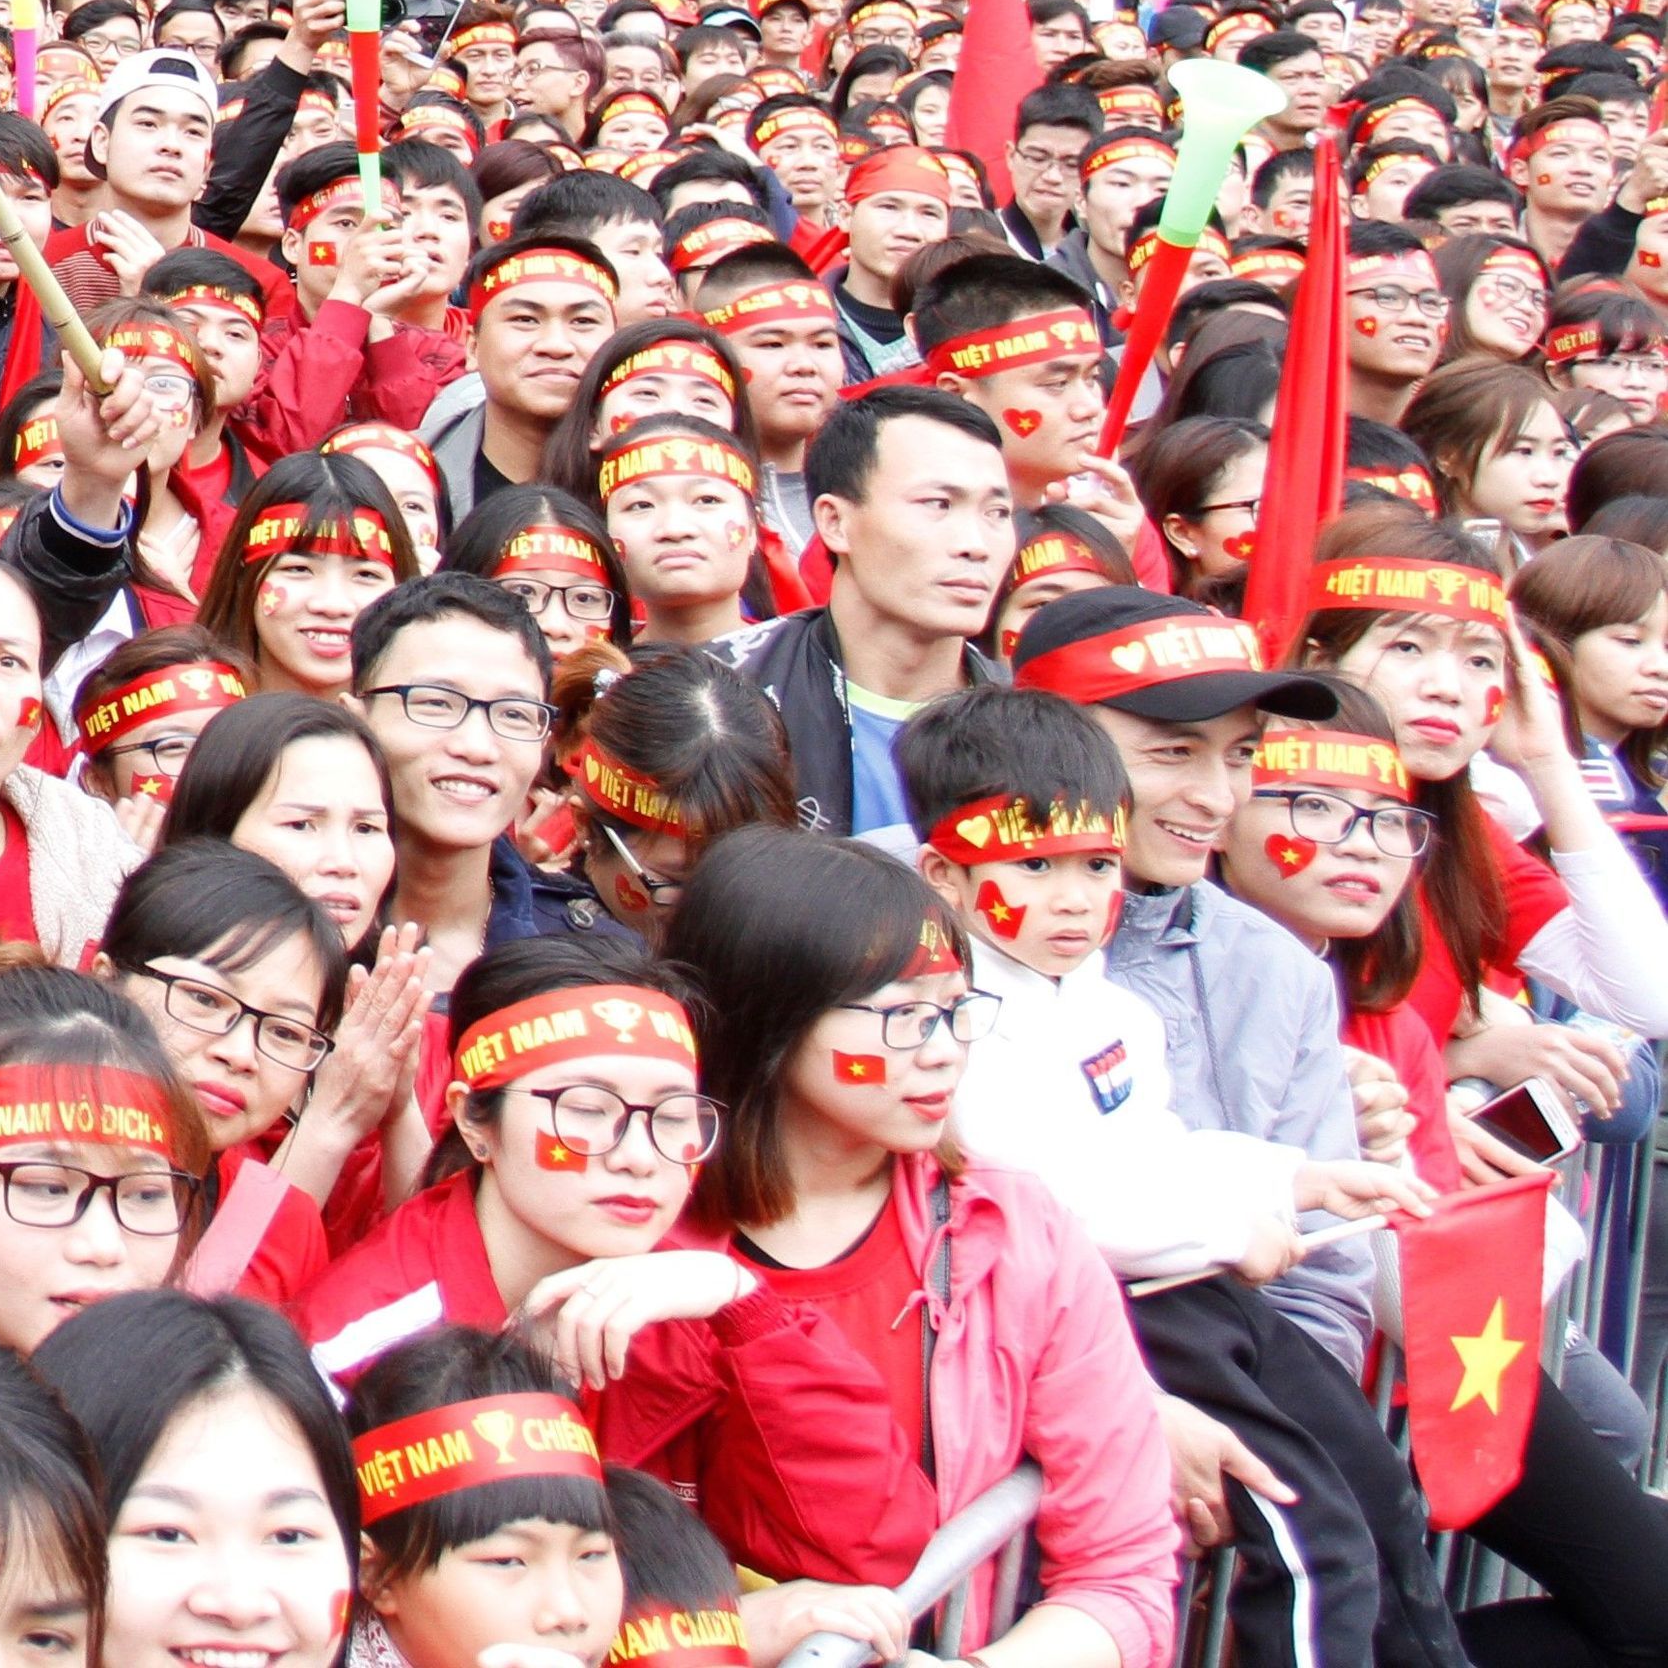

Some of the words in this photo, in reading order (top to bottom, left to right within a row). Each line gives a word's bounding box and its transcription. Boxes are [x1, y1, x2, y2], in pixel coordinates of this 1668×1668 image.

[951, 343, 992, 369] VIỆT
[995, 330, 1049, 359] NAM
[1019, 538, 1066, 575] NAM
[86, 704, 121, 737] VIỆT
[122, 679, 177, 716] NAM
[1316, 741, 1370, 776] NAM
[460, 1032, 508, 1080] VIỆT
[509, 1008, 588, 1055] NAM
[59, 1097, 96, 1133] VÔ
[101, 1105, 153, 1147] ĐỊCH
[356, 1449, 407, 1499] VIỆT
[407, 1430, 473, 1479] NAM
[608, 1614, 672, 1664] NAM
